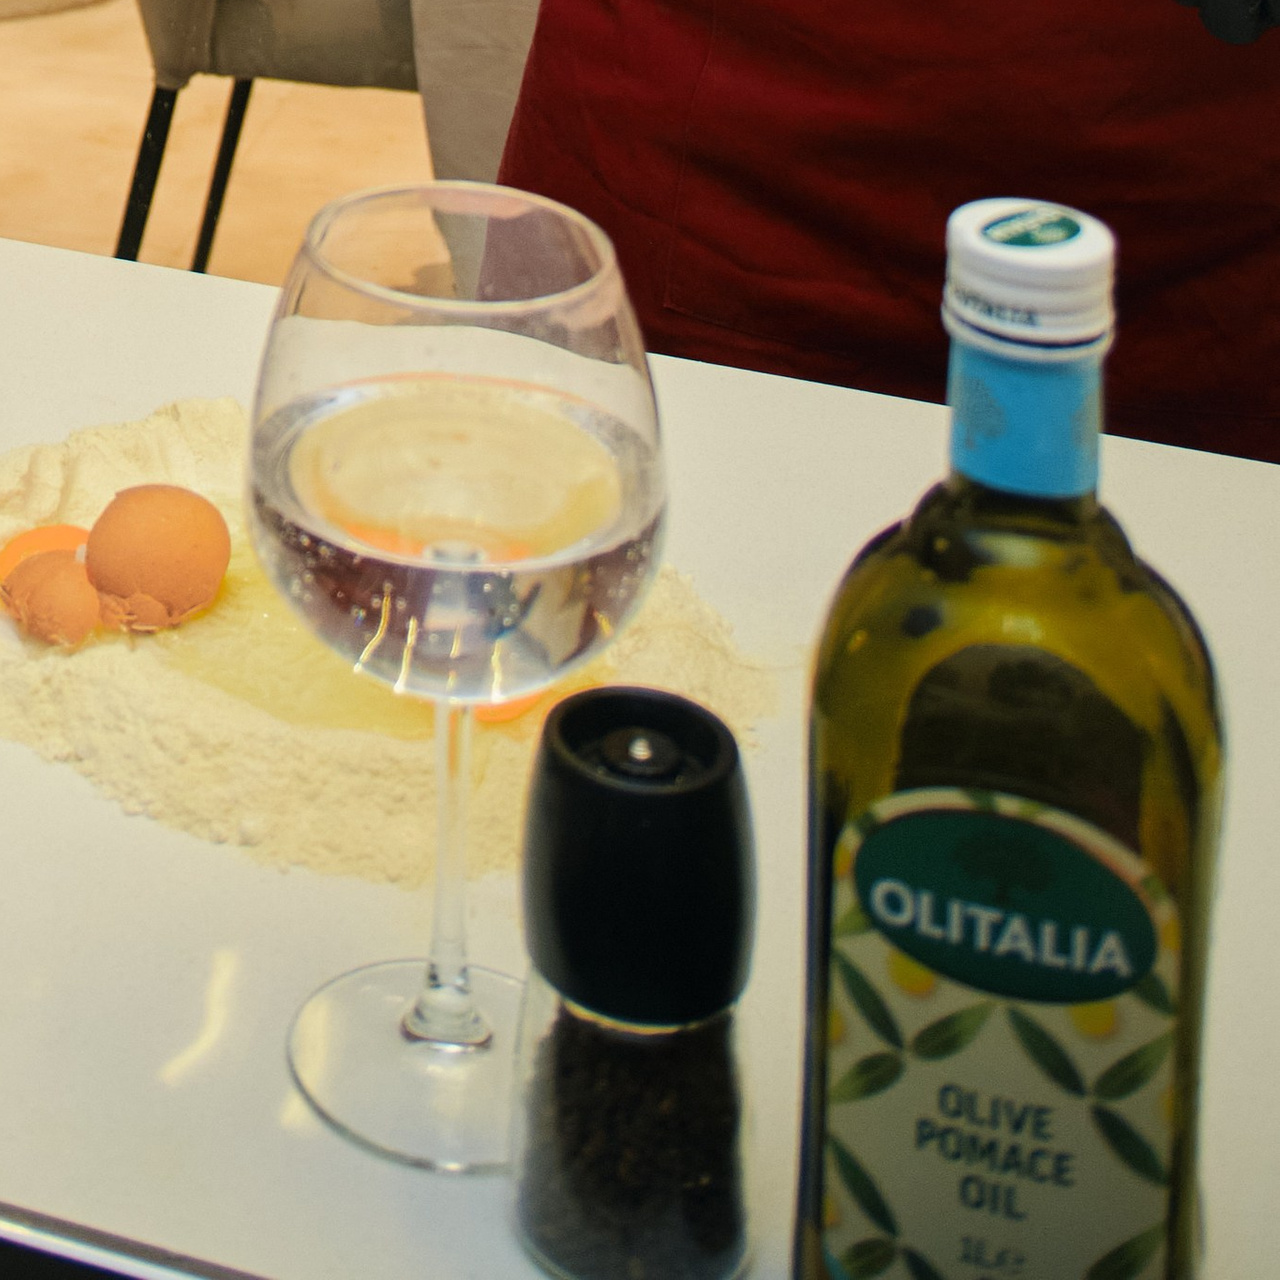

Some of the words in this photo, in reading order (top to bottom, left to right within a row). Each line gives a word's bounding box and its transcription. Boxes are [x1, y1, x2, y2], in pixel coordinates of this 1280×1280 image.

[868, 878, 1133, 979] OLITALIA
[937, 1083, 1053, 1141] OLIVE
[915, 1118, 1075, 1187] POMACE
[958, 1176, 1027, 1221] OIL
